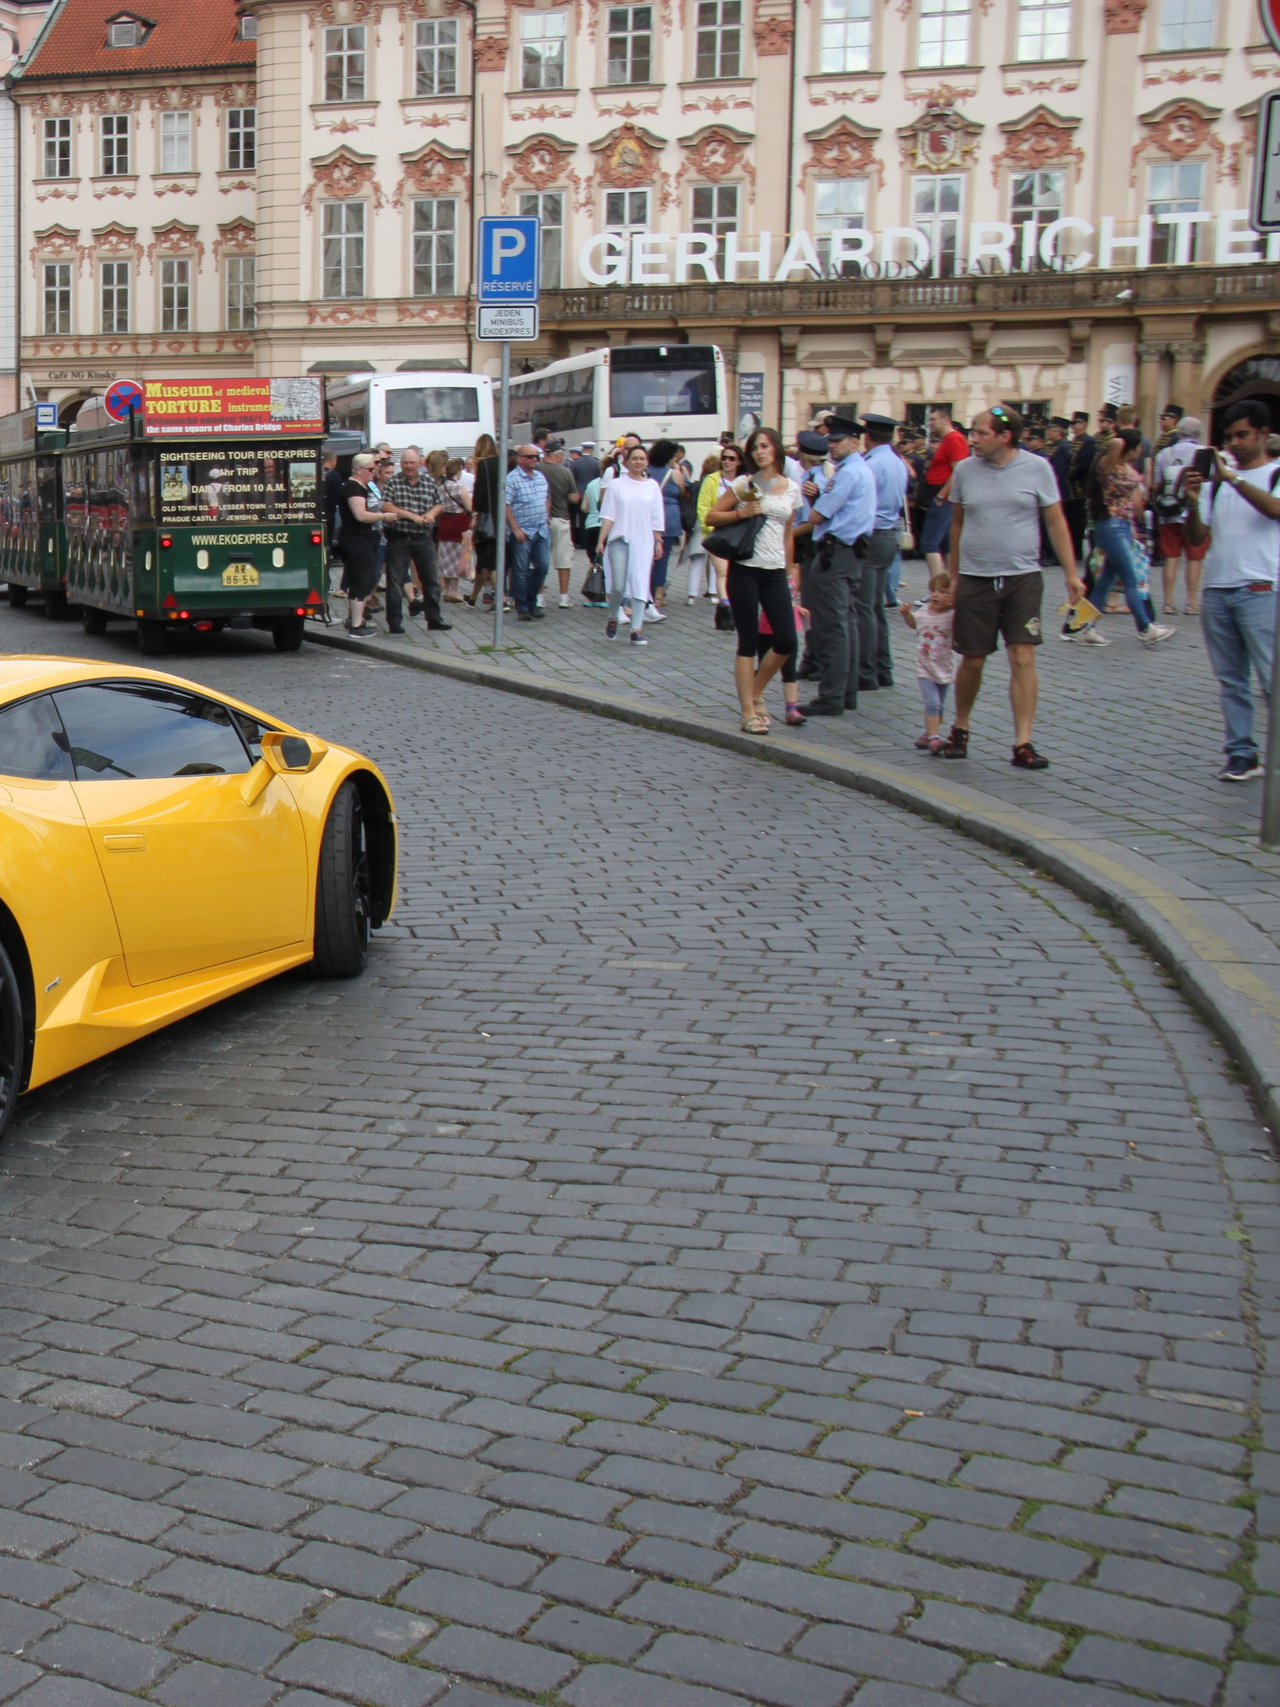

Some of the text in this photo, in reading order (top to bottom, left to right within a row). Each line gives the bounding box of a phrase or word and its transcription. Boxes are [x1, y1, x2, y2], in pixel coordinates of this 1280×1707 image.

[491, 228, 526, 276] P
[578, 209, 1280, 286] GERHARD RICHTE
[482, 280, 533, 292] RÉSERVÉ
[494, 309, 521, 317] JEDEN
[483, 327, 531, 336] EKOEXPRES
[48, 370, 117, 380] Café NG Kinský
[145, 382, 214, 398] Museum
[226, 385, 270, 396] medieval
[145, 399, 222, 414] TORTURE
[146, 425, 160, 434] the
[184, 425, 212, 433] square
[214, 424, 222, 432] of
[223, 423, 254, 431] Charles
[255, 423, 282, 431] Bridge
[160, 449, 317, 462] SIGHTSEEING TOUR EKOEXPRES
[236, 467, 259, 476] TRIP
[223, 484, 251, 493] FROM
[253, 484, 264, 492] 10
[265, 483, 287, 492] A.M.
[191, 532, 289, 546] WWW.EKOEXPRES.CZ
[234, 565, 247, 574] AR
[226, 575, 255, 585] 86-54
